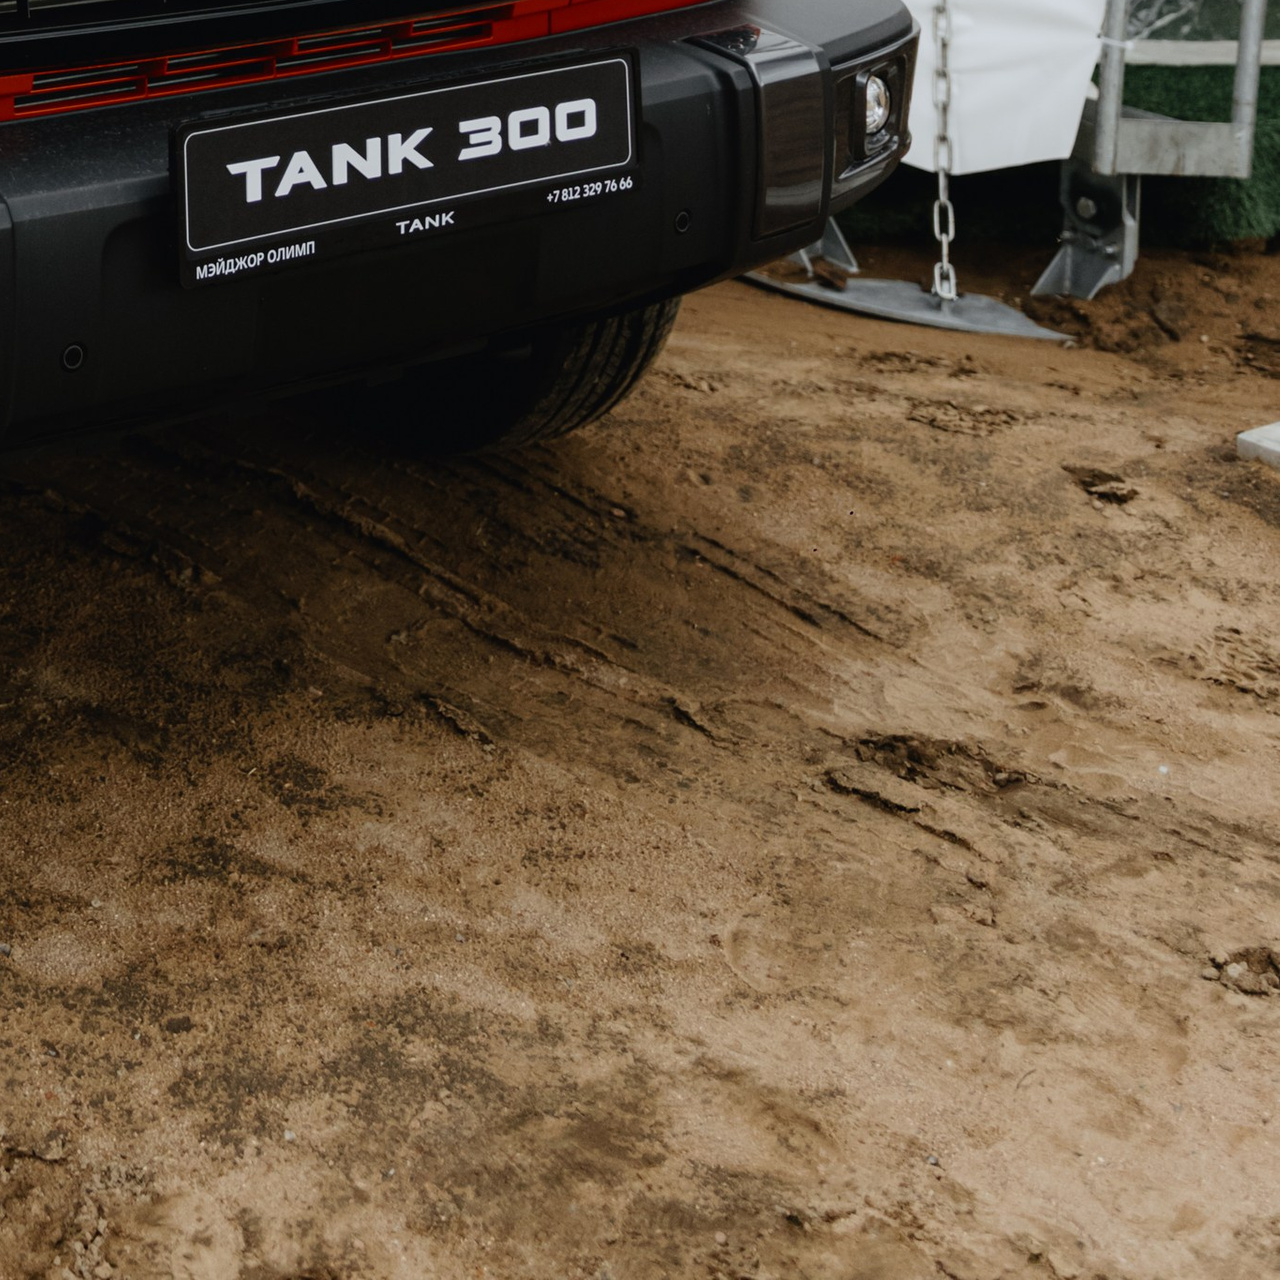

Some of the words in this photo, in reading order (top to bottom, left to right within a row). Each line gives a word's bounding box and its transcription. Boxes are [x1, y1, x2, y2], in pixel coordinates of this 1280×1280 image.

[226, 127, 434, 203] TANK
[457, 98, 597, 162] 300
[546, 190, 560, 203] +7
[561, 186, 581, 201] 812
[582, 182, 602, 197] 329
[604, 179, 618, 193] 76
[619, 176, 633, 190] 66
[396, 211, 455, 235] TANK
[195, 251, 265, 281] МЭЙДЖОР
[266, 240, 316, 264] ОЛИМП
